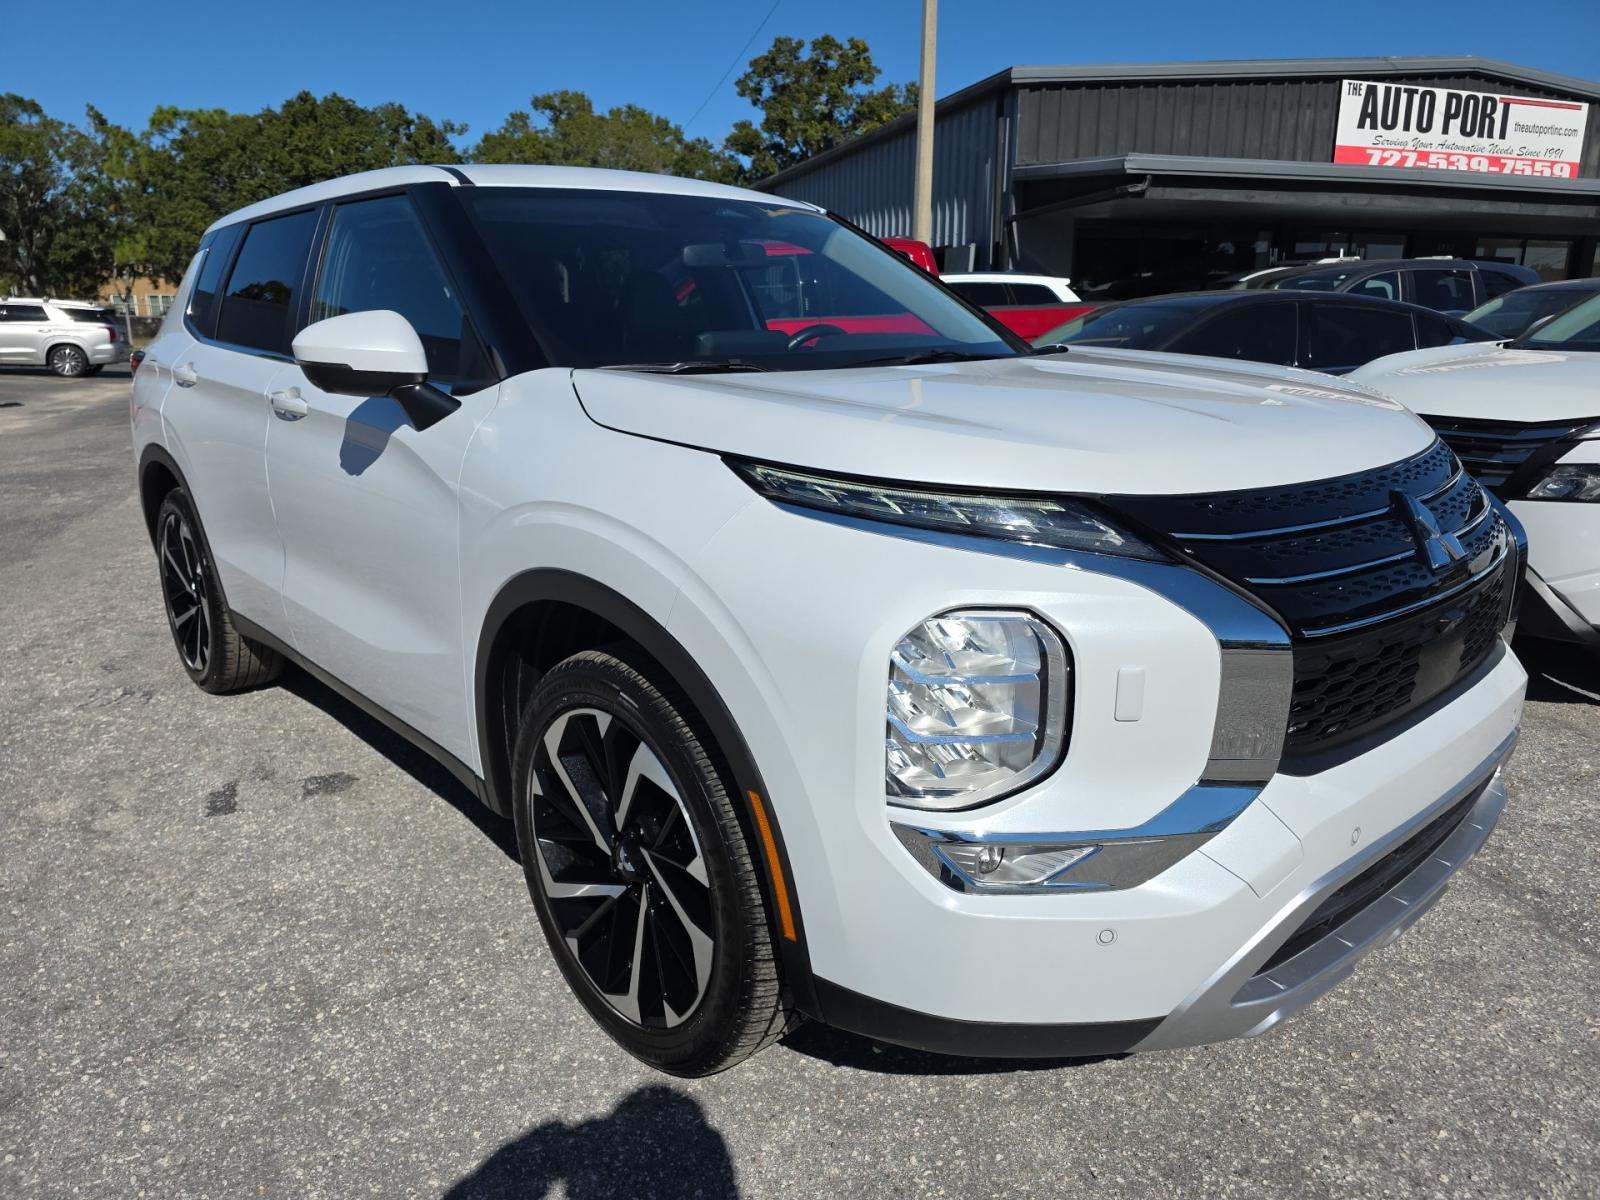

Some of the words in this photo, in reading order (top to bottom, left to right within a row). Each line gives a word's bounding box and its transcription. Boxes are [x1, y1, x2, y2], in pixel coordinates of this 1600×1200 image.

[1347, 82, 1362, 96] THE
[1357, 84, 1436, 134] AUTO
[1441, 92, 1511, 140] PORT
[1514, 121, 1578, 138] theautoportinc.com
[1372, 135, 1409, 150] Serving
[1411, 137, 1433, 150] Your
[1435, 140, 1486, 153] Automotive
[1488, 143, 1514, 155] Needs
[1516, 146, 1541, 157] Since
[1543, 147, 1565, 159] 1991
[1365, 149, 1571, 178] 727-539-7559
